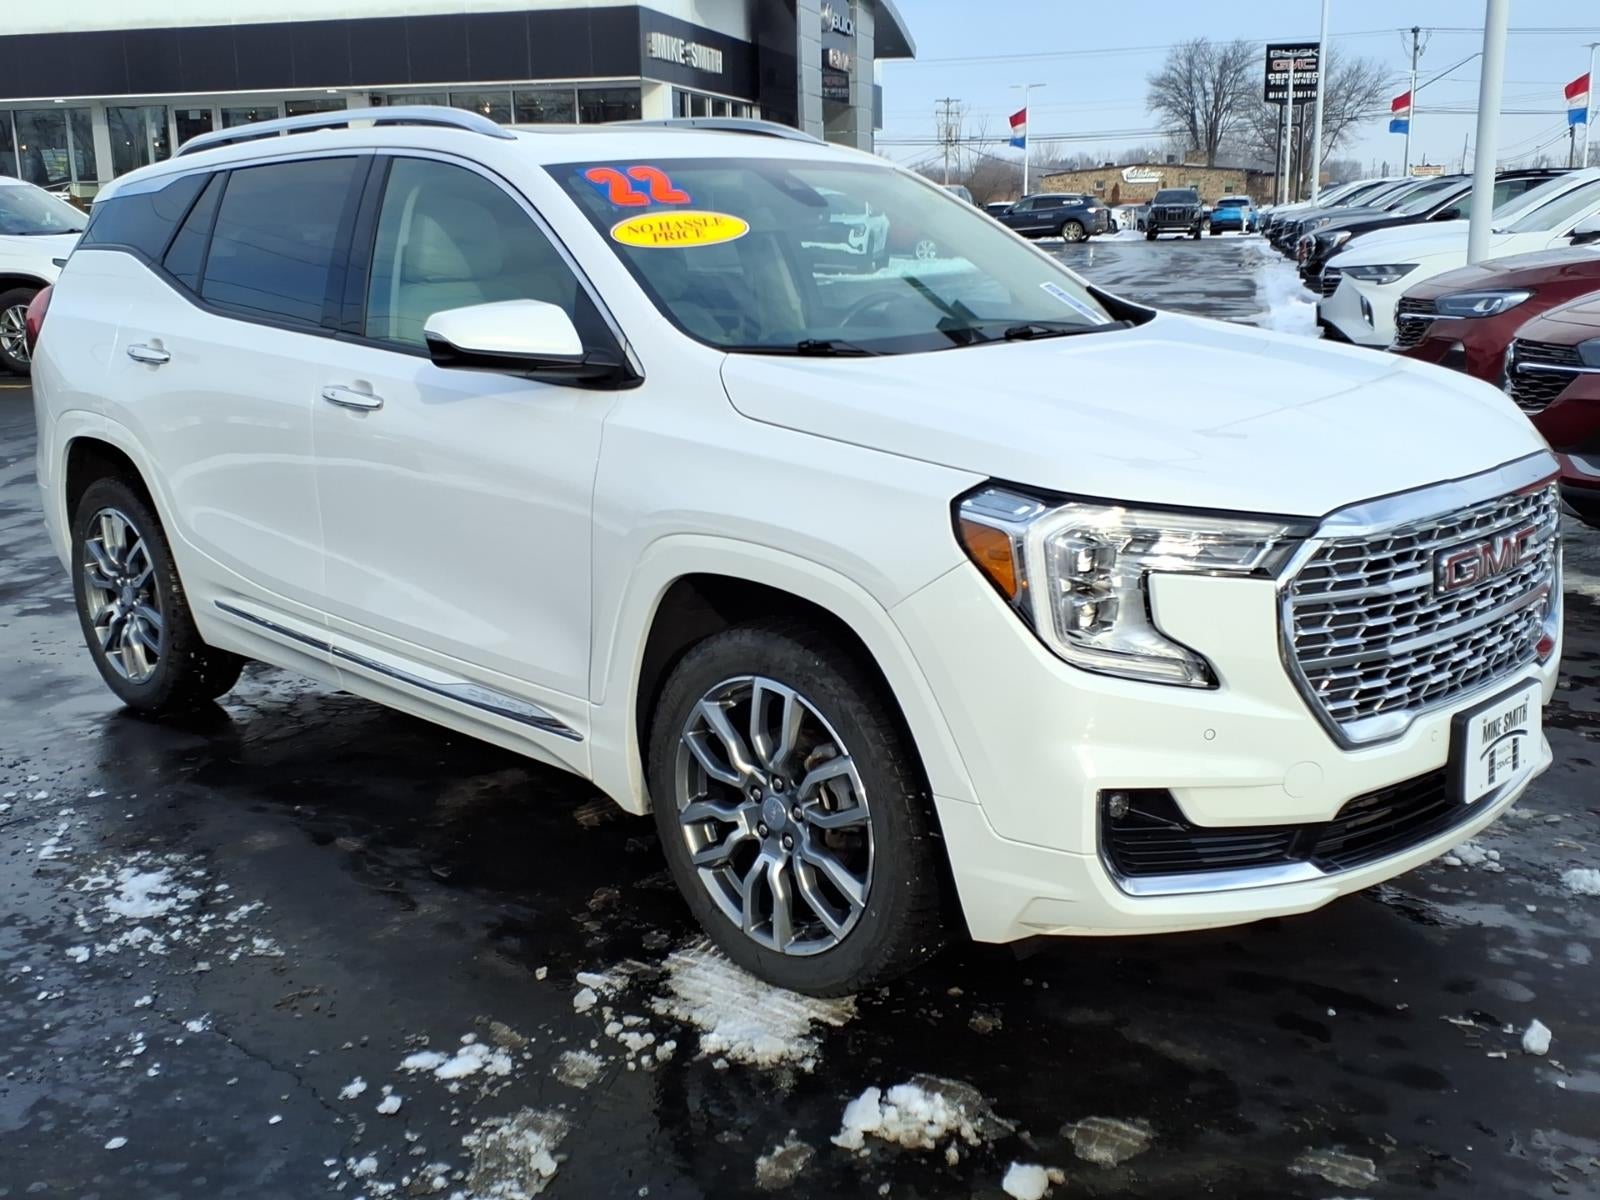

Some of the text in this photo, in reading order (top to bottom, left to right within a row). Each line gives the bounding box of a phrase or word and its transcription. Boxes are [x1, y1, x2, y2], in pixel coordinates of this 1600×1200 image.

[651, 32, 722, 74] MIKE SMITH
[1269, 49, 1319, 58] BUICK
[1273, 58, 1316, 71] GMC
[1268, 72, 1320, 80] CERIFIED
[1270, 78, 1316, 86] PRE-WNED
[1292, 90, 1316, 98] SMITH
[584, 165, 691, 206] 22
[627, 217, 725, 235] NO HASSLE
[653, 228, 706, 243] PRICE
[1445, 526, 1537, 591] GMC
[1482, 703, 1528, 745] MIKE SMITH
